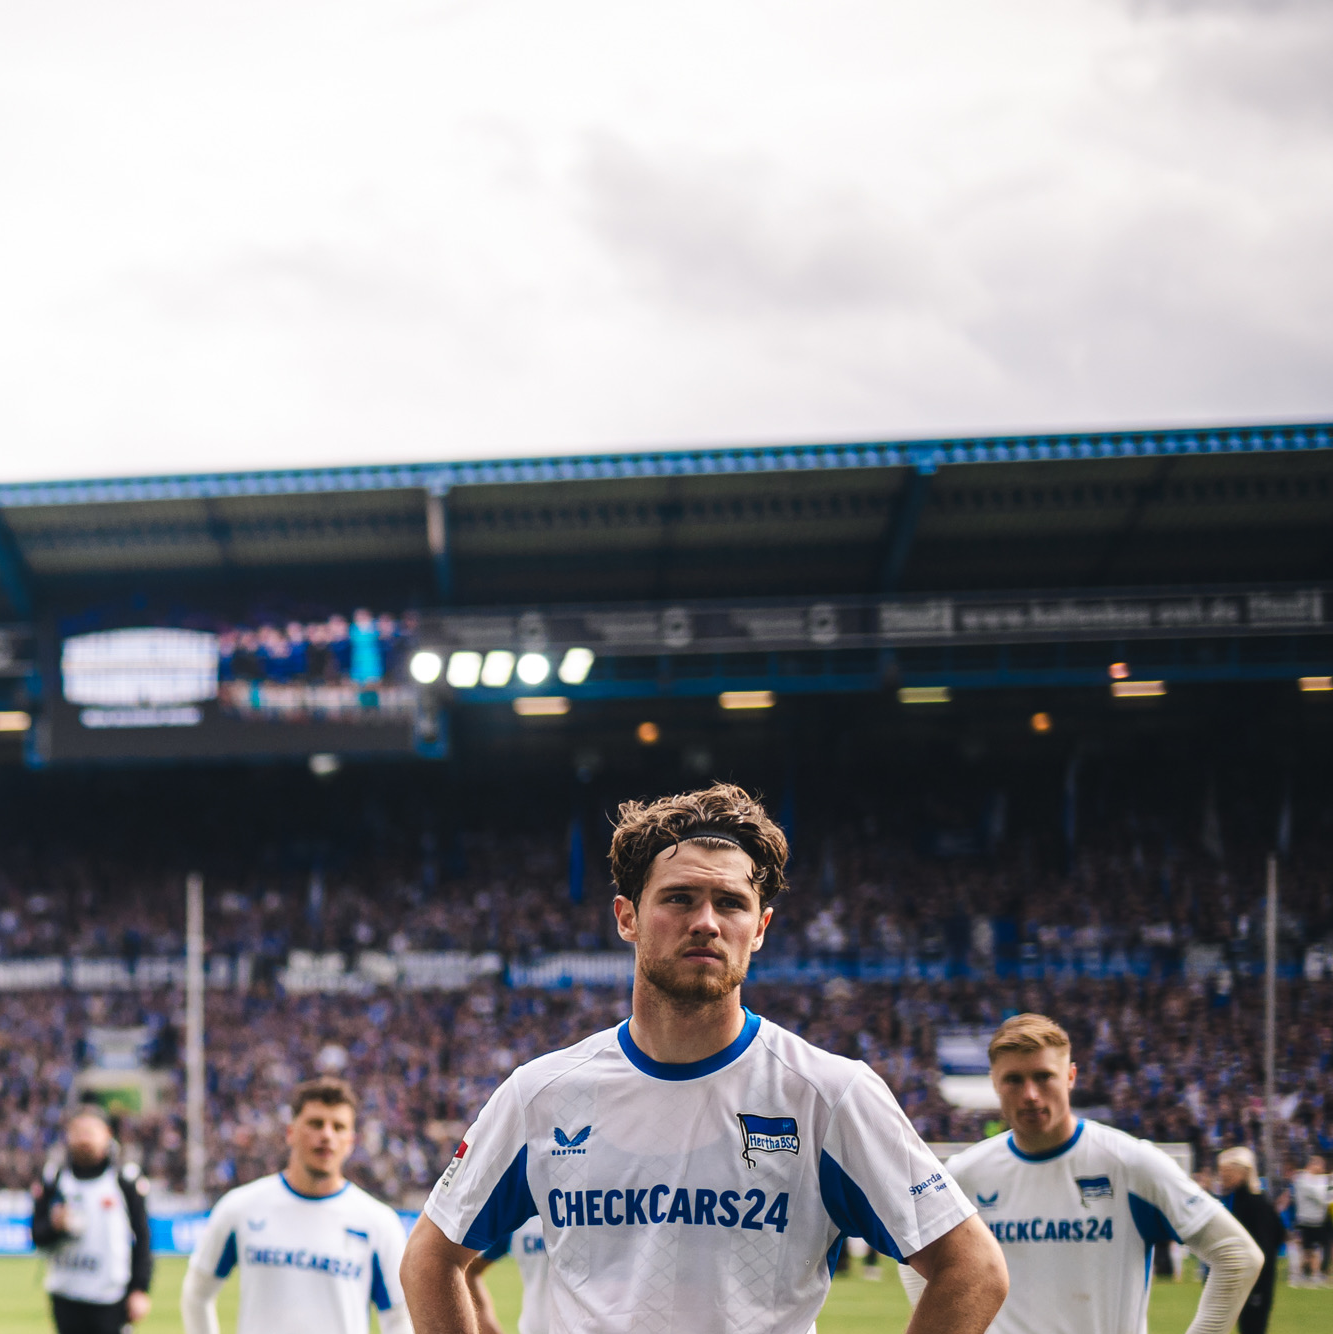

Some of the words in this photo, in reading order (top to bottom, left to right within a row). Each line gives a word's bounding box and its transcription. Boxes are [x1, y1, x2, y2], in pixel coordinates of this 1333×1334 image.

[749, 1134, 780, 1150] Hertha
[781, 1136, 798, 1150] BSC
[908, 1172, 942, 1196] Sparda
[548, 1184, 790, 1234] CHECKCARS24
